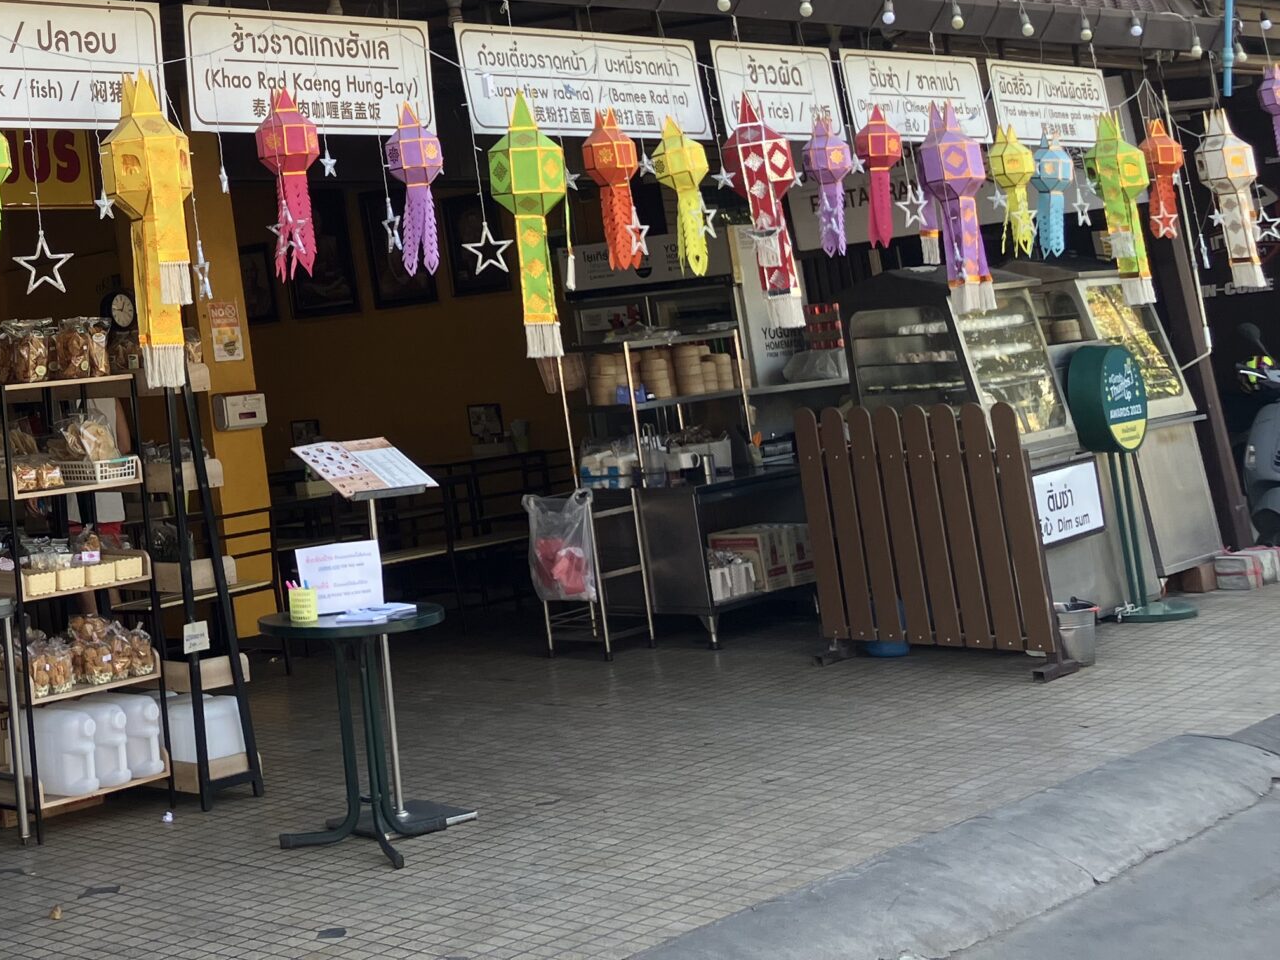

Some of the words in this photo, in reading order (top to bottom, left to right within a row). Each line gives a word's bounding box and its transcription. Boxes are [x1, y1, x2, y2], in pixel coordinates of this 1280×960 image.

[10, 21, 24, 53] /
[37, 19, 117, 55] ปลาอบ
[231, 22, 390, 61] ข้าวราดแกงฮังเล
[747, 54, 803, 87] ข้าวผัด
[13, 78, 22, 100] /
[29, 79, 63, 102] fish)
[70, 80, 79, 101] /
[205, 68, 252, 91] (Khao
[258, 71, 287, 90] Rad
[293, 72, 341, 98] Kaeng
[347, 74, 418, 102] Hung-Lay)
[608, 88, 648, 105] (Bamee
[650, 91, 670, 106] Rad
[672, 93, 689, 107] na)
[252, 98, 381, 120] 泰肉咖喱酱盖饭
[768, 100, 794, 122] rice)
[211, 308, 225, 318] NO
[1109, 406, 1130, 419] AWARDS
[1130, 404, 1142, 416] 2023
[1057, 517, 1074, 533] Dim
[1075, 513, 1090, 528] sum
